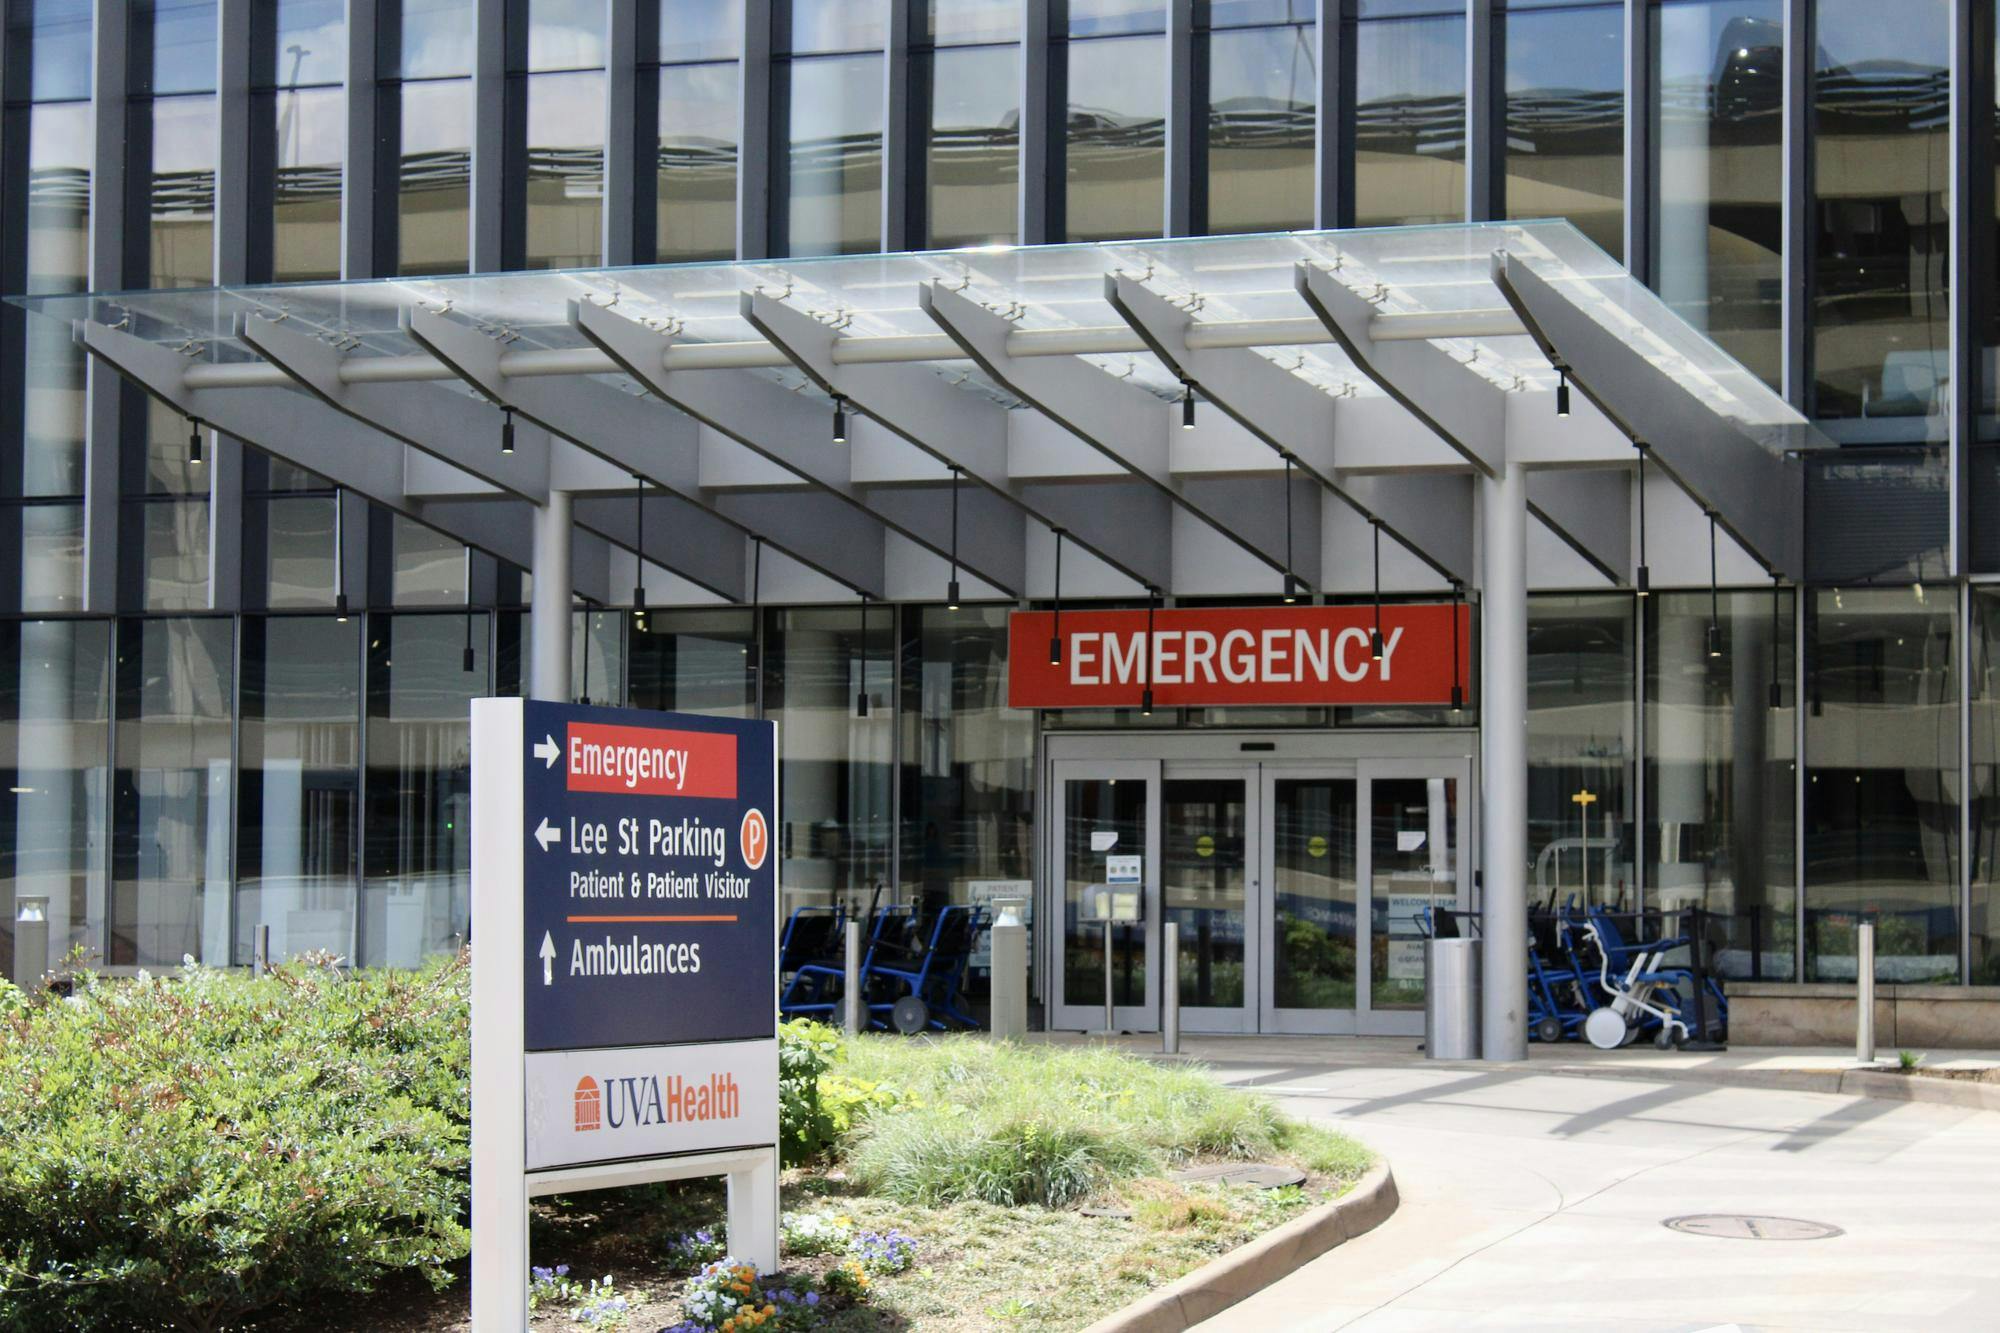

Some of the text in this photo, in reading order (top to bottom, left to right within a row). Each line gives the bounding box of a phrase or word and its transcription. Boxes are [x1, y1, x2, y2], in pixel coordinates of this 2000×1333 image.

[1070, 627, 1404, 685] EMERGENCY
[570, 736, 688, 790] Emergency
[570, 816, 726, 868] Lee St Parking
[748, 818, 761, 860] P
[570, 870, 751, 899] Patient & Patient Visitor
[1391, 897, 1434, 907] WELCOM
[570, 935, 701, 976] Ambulances
[604, 1072, 739, 1129] UVA Health
